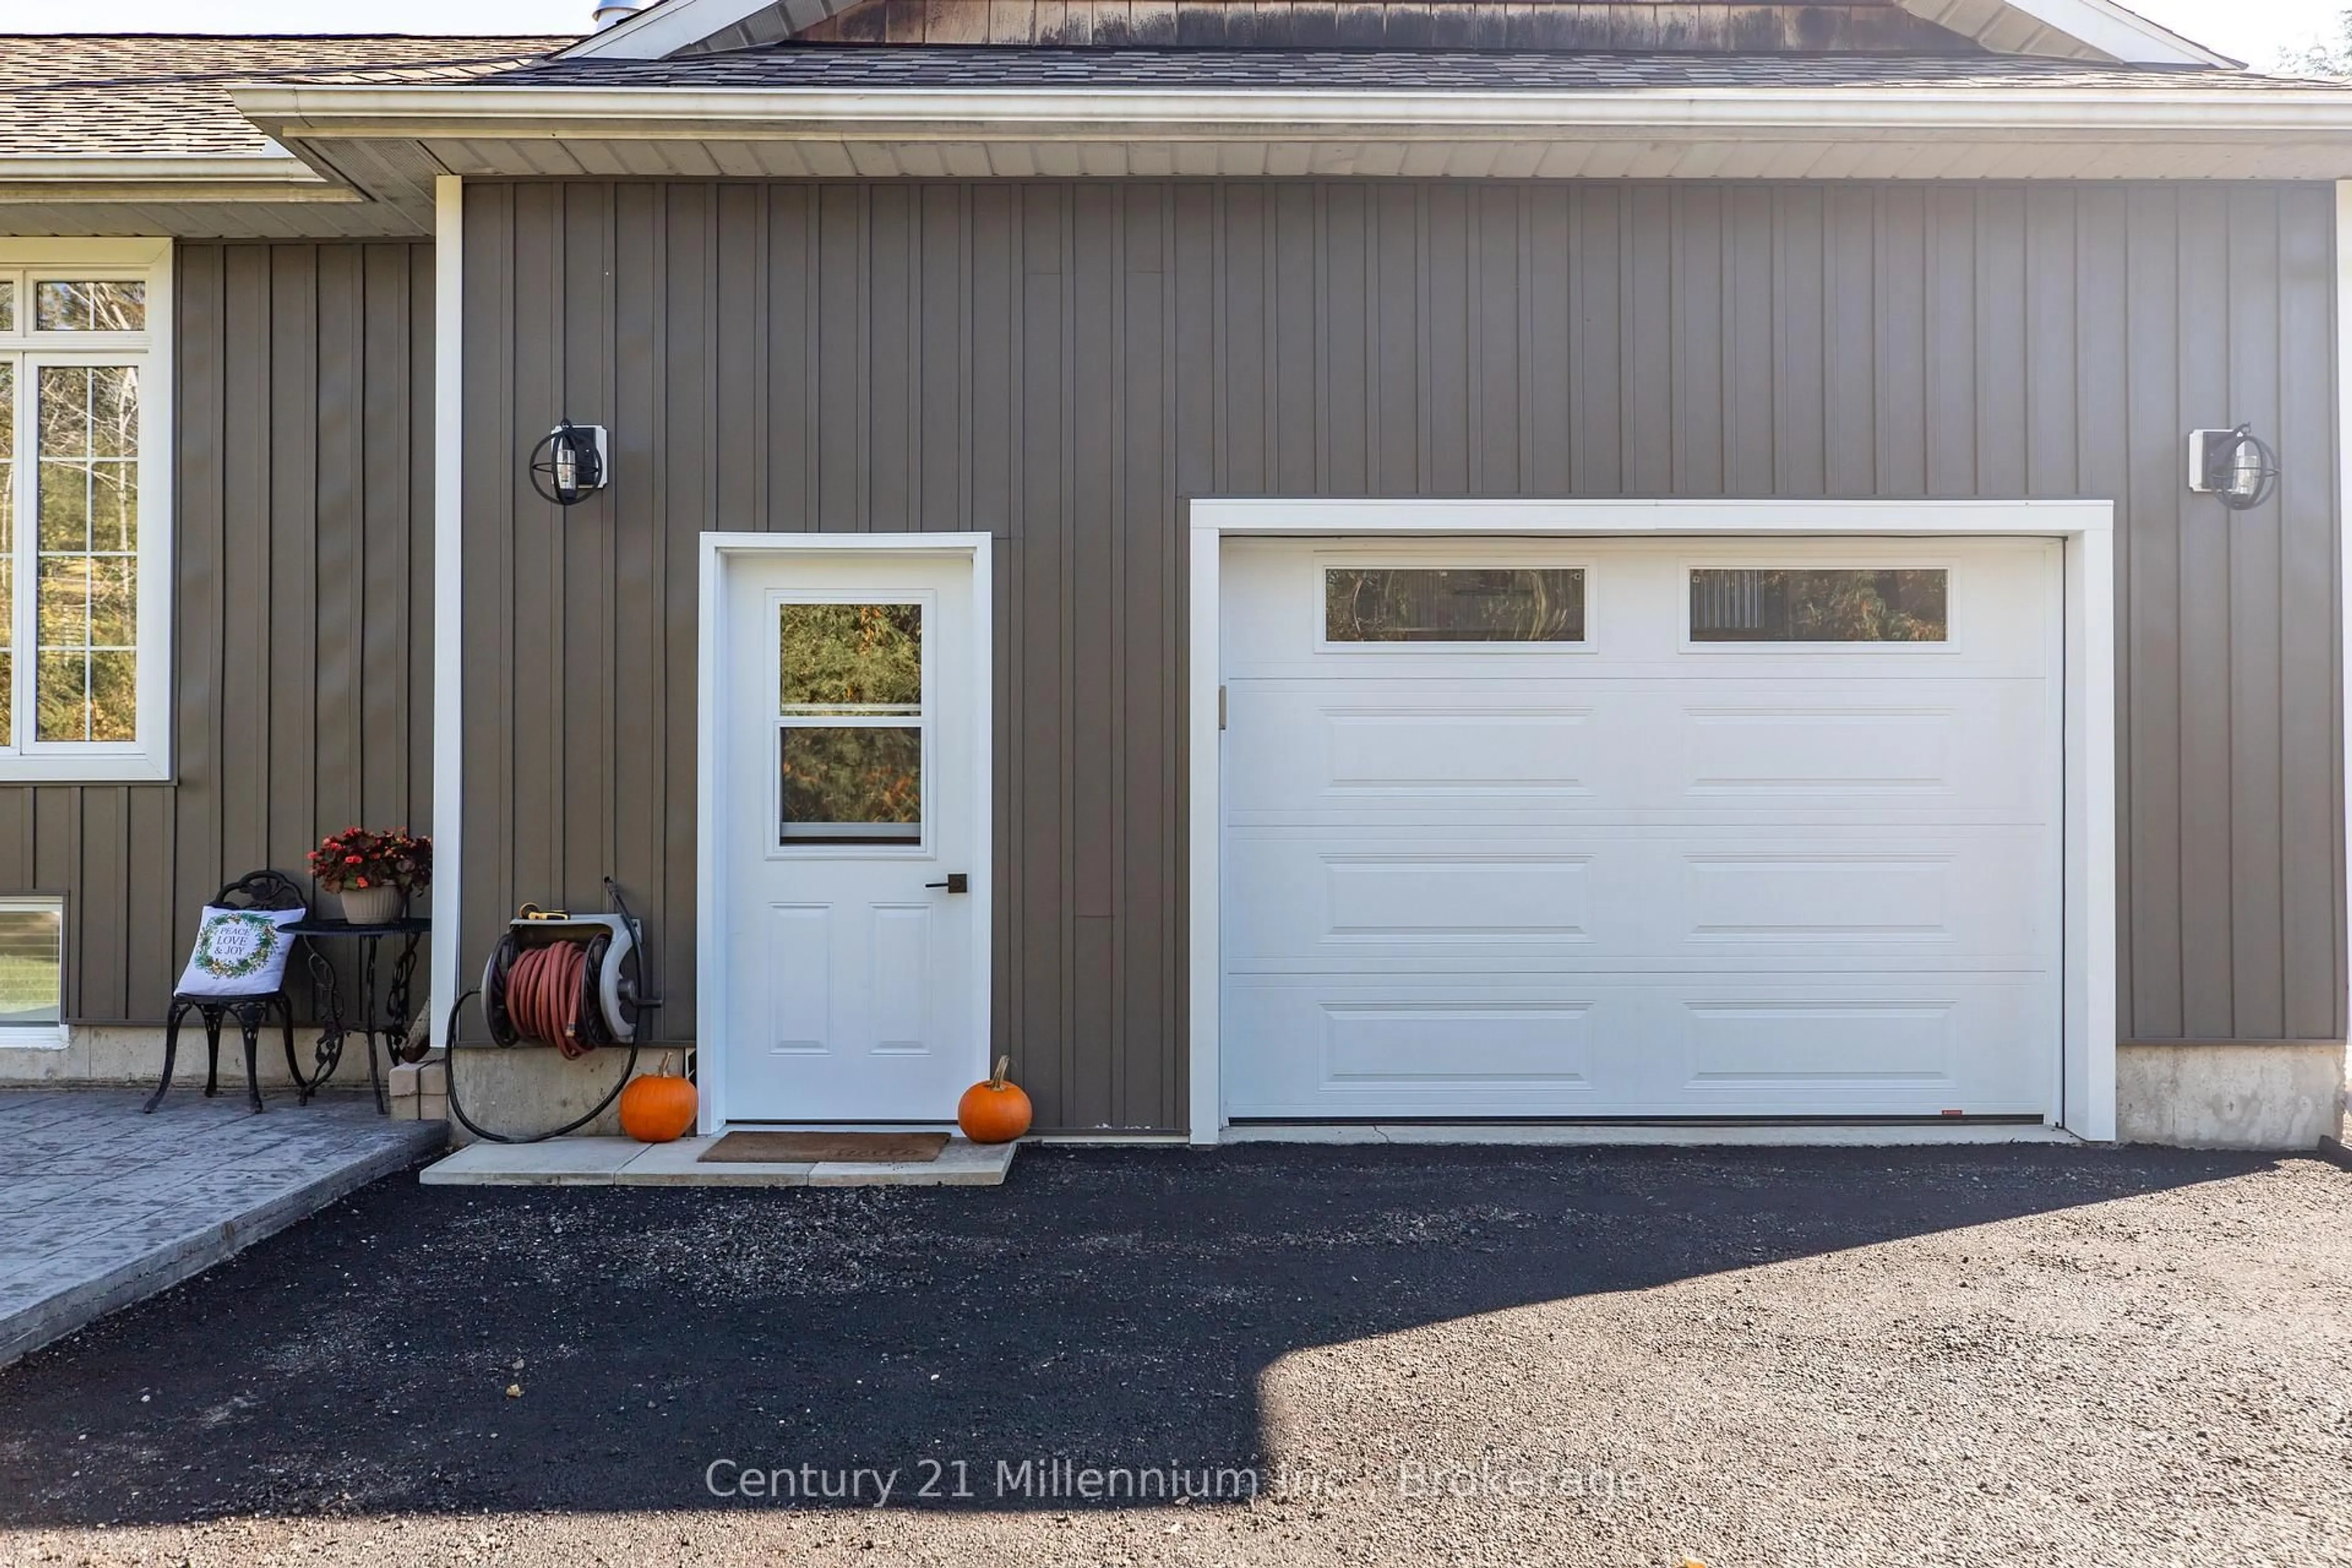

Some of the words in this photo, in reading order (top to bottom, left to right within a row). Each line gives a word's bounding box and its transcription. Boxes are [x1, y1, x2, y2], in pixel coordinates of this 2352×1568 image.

[217, 935, 248, 946] LOVE
[214, 946, 223, 955] &
[224, 946, 245, 956] JOY
